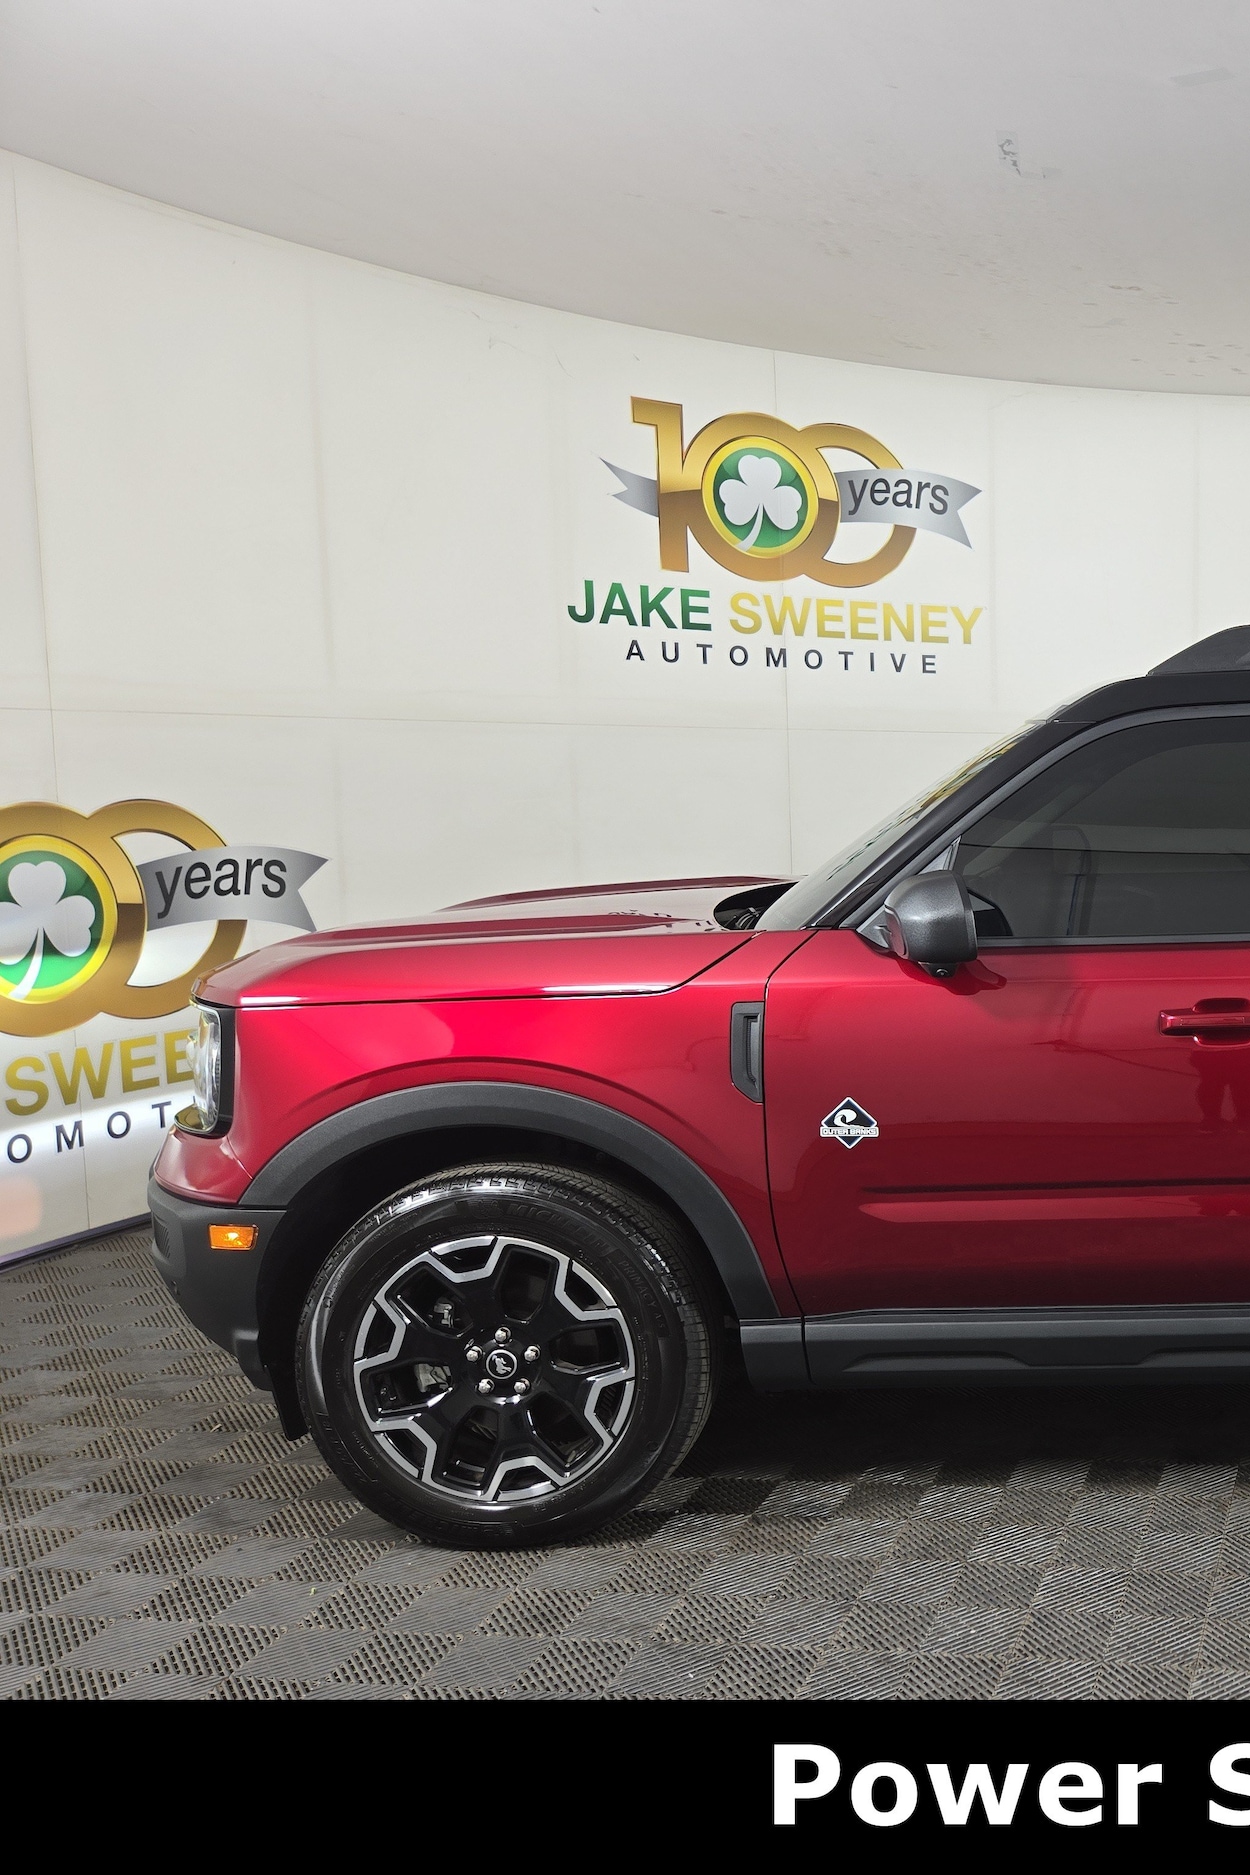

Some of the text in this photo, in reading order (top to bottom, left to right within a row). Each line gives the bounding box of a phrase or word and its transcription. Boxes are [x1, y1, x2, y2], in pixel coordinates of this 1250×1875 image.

[631, 396, 949, 587] 100 years
[567, 579, 982, 645] JAKE SWEENEY
[625, 639, 937, 674] AUTOMOTIVE
[155, 857, 287, 919] years
[5, 1029, 198, 1116] SWEE
[849, 1128, 876, 1136] BANKS
[618, 1259, 658, 1308] PRIMACY
